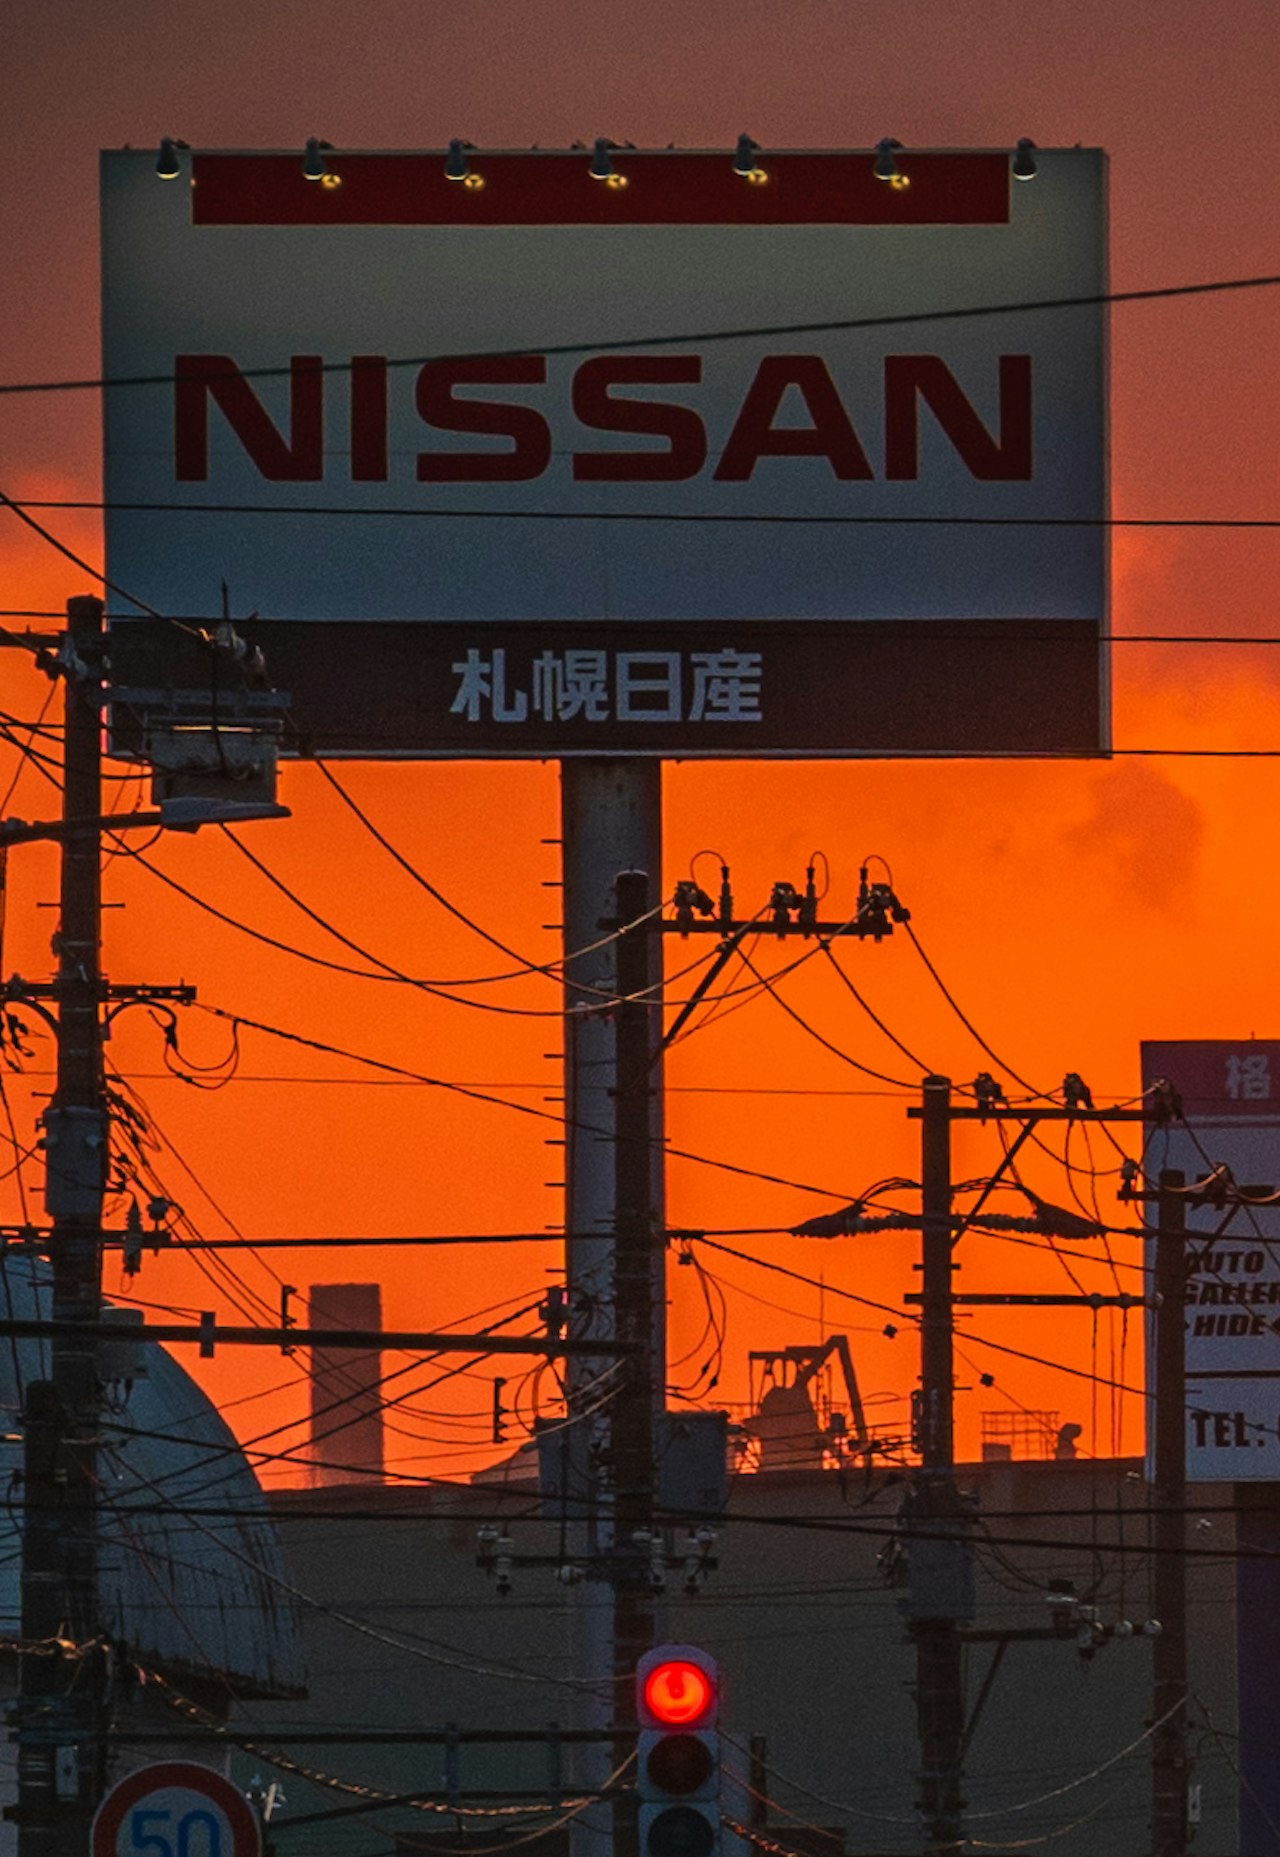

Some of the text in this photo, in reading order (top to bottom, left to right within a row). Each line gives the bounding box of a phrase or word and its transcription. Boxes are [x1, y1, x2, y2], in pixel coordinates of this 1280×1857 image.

[174, 353, 1032, 482] NISSAN
[450, 647, 763, 723] 札幌日産
[1184, 1250, 1265, 1273] AUTO
[1194, 1312, 1266, 1336] HIDE
